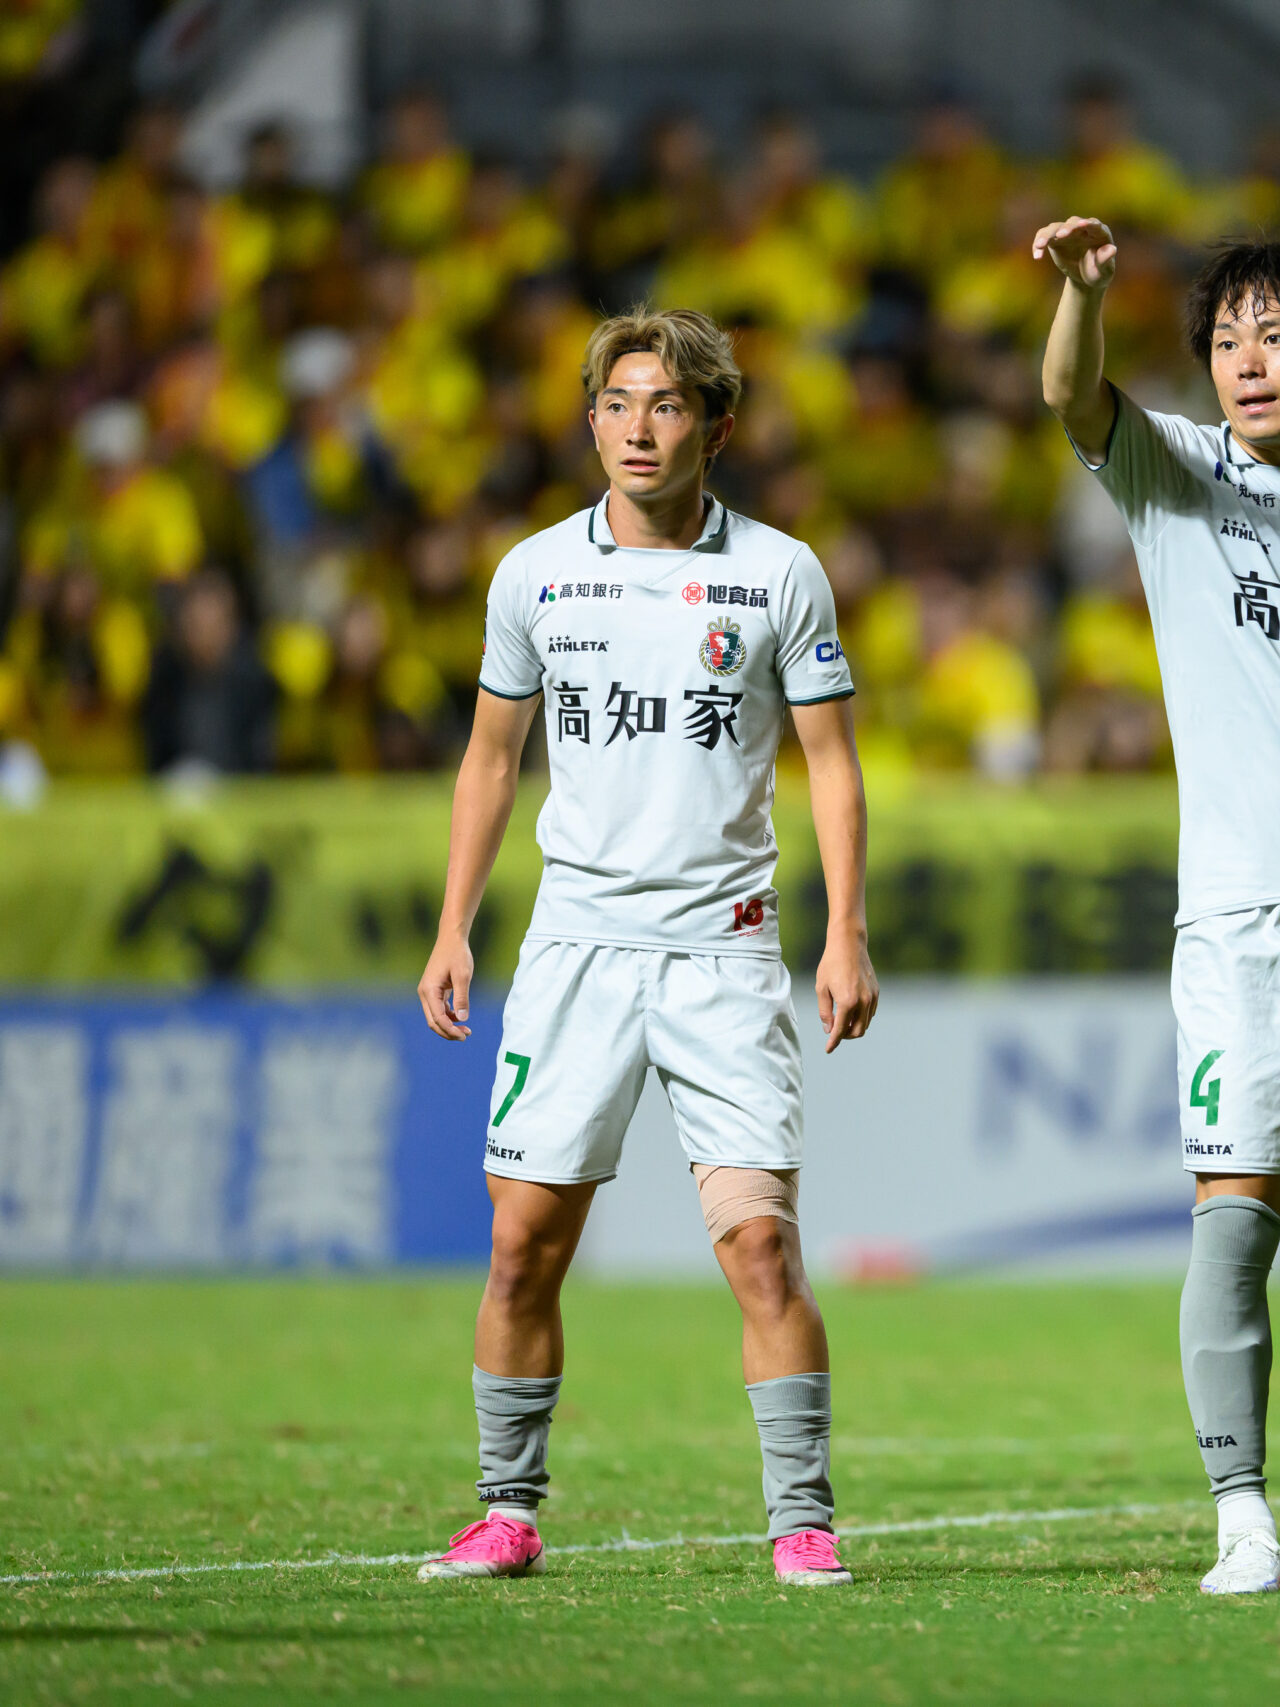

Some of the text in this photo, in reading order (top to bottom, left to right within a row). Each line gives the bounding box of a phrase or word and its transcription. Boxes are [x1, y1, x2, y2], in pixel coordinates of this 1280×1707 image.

[560, 583, 623, 599] 高知銀行
[706, 584, 768, 608] 旭食品
[548, 641, 607, 653] ATHLETA
[552, 681, 744, 751] 高知家
[491, 1051, 531, 1127] 7
[1190, 1050, 1225, 1126] 4
[487, 1143, 523, 1161] THLETA
